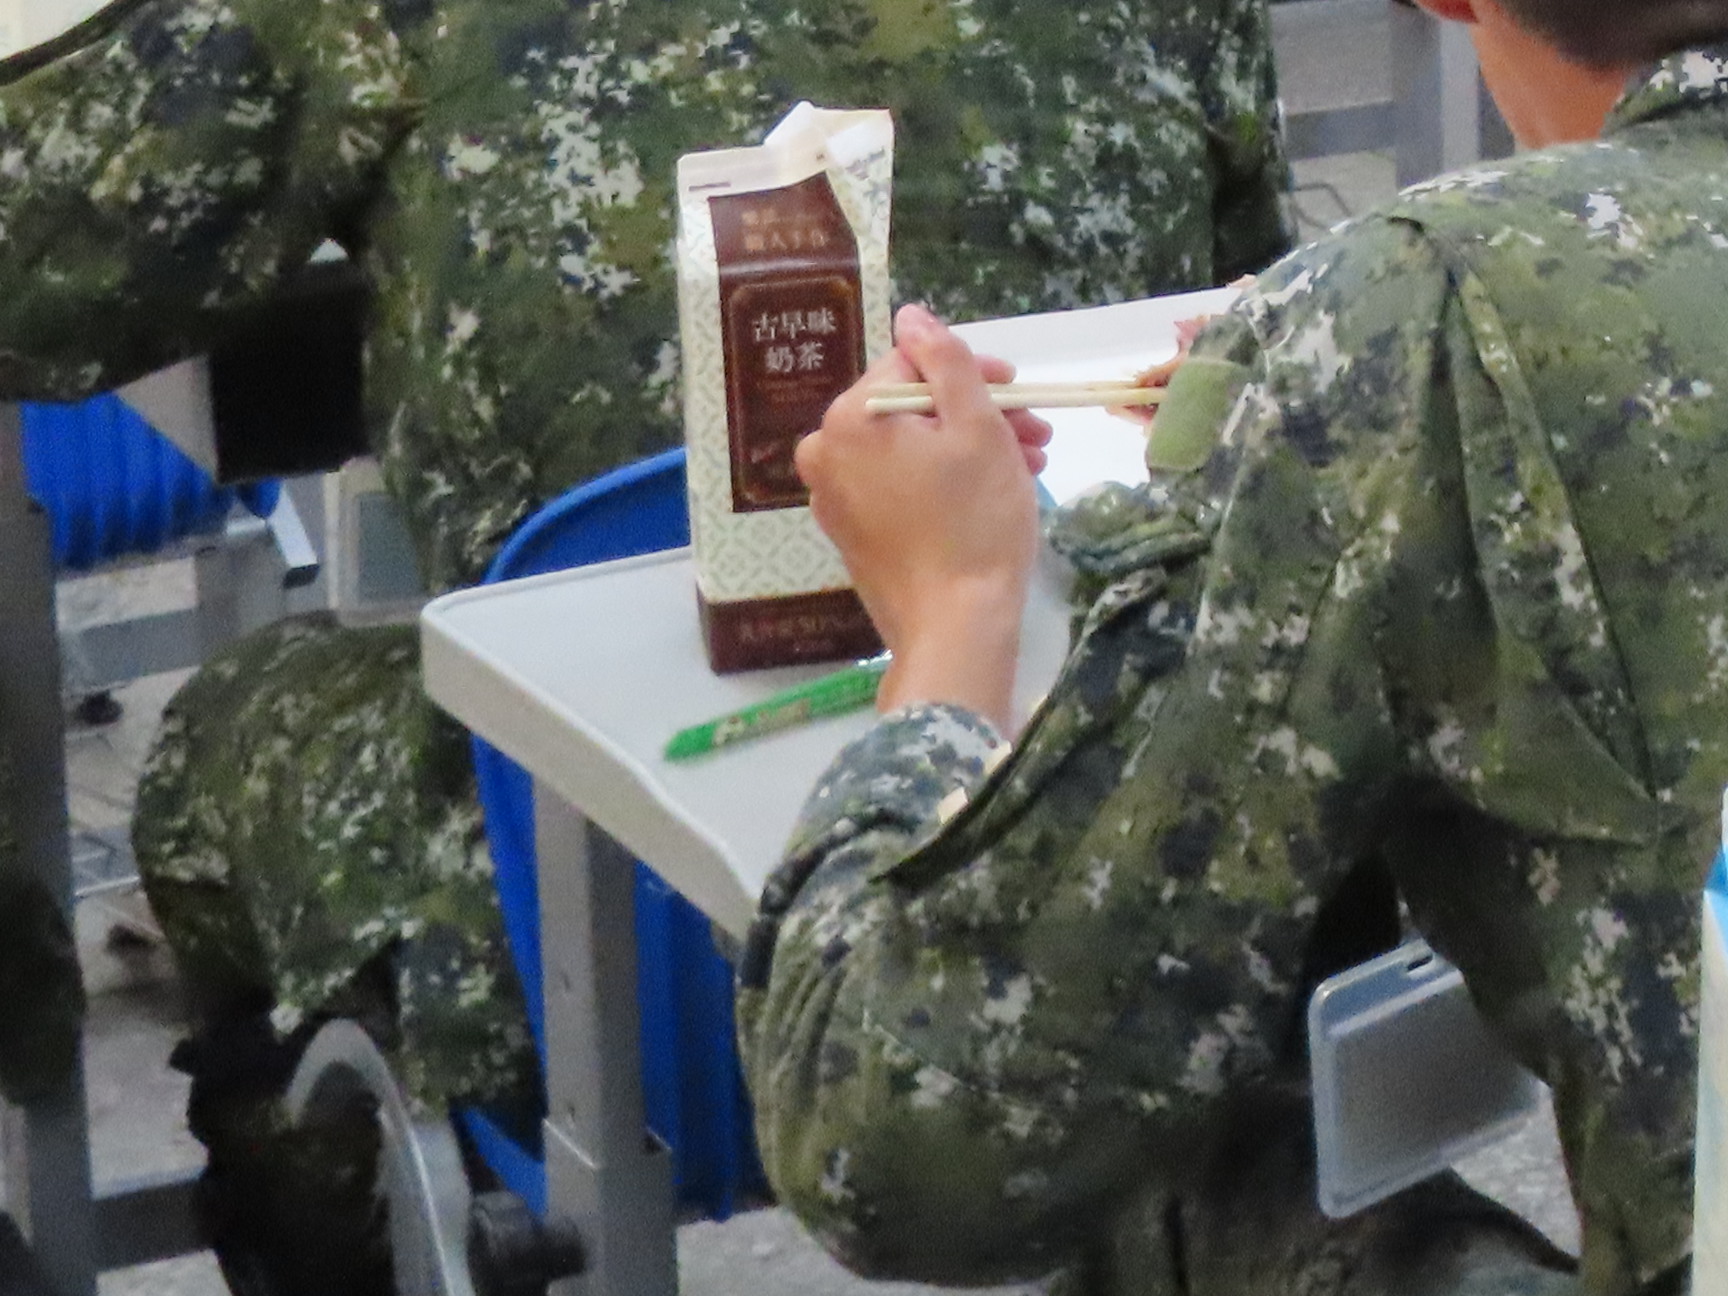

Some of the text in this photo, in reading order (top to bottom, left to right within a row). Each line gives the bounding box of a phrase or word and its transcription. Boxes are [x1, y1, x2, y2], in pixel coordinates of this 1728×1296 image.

[751, 307, 837, 342] 古早味
[764, 341, 825, 373] 奶茶
